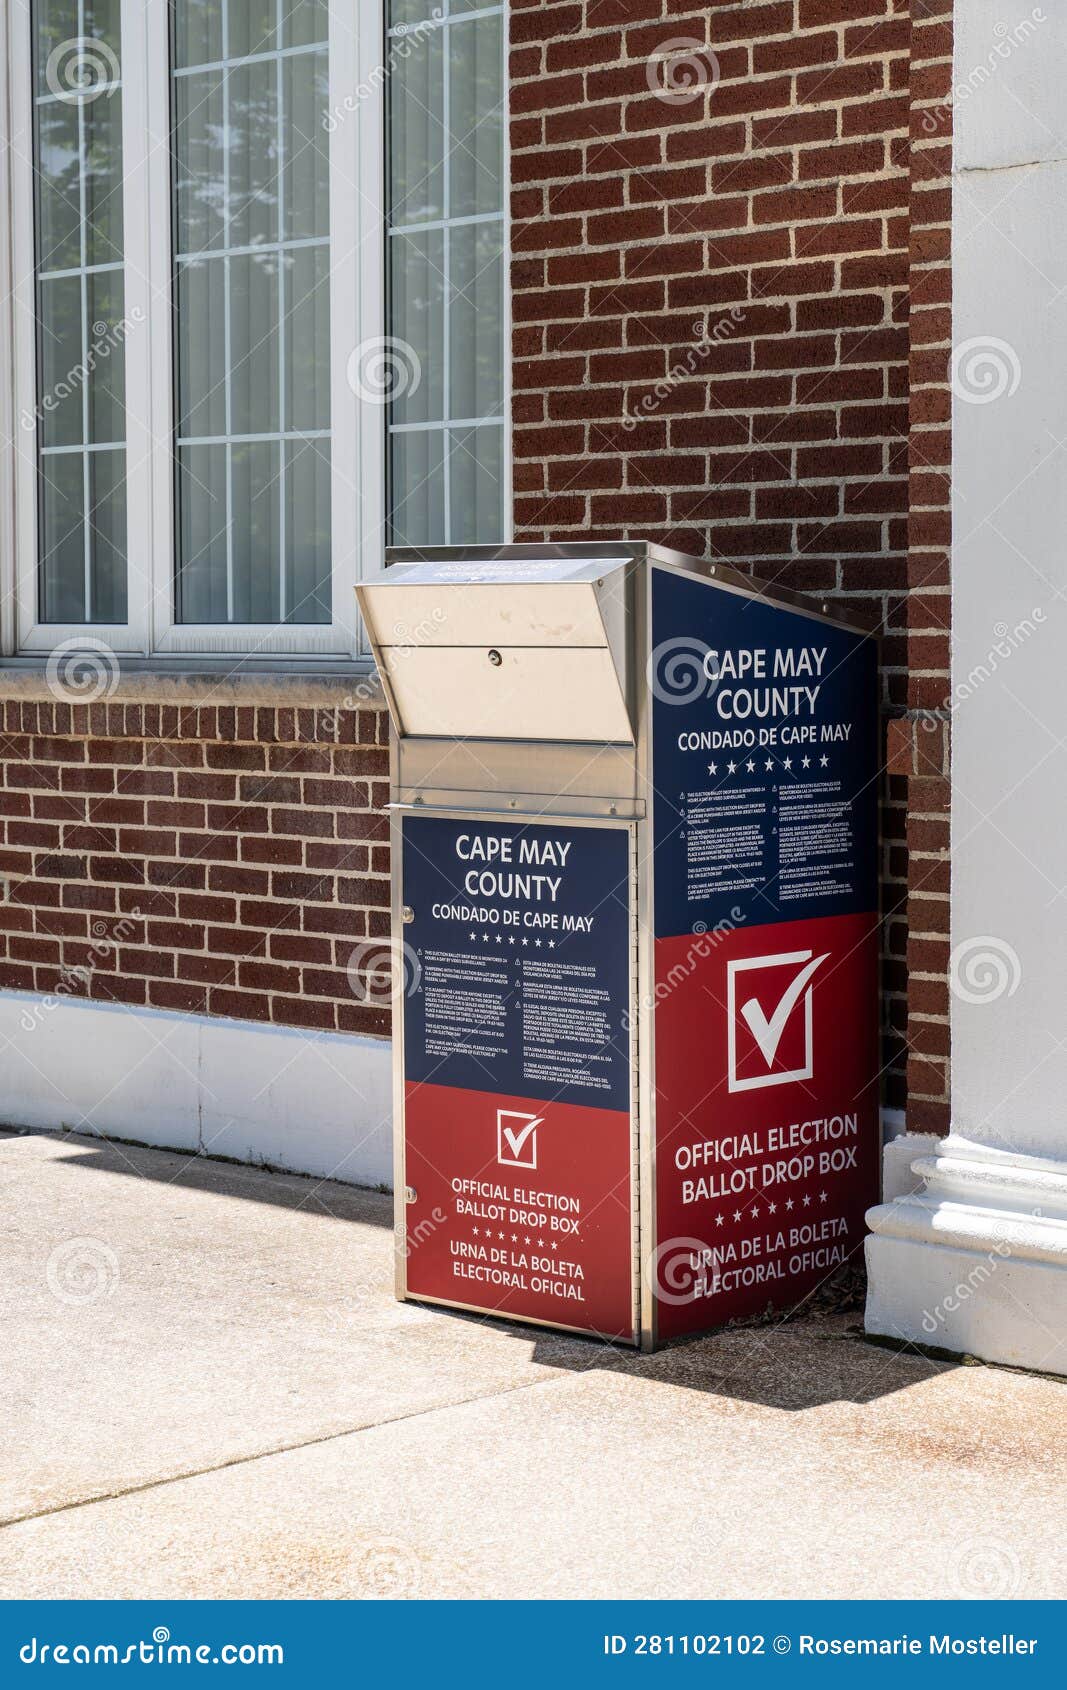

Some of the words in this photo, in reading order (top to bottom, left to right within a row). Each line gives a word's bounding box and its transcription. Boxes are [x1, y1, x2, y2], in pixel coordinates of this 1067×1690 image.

[703, 649, 766, 680] CAPE
[773, 648, 827, 677] MAY
[716, 686, 820, 719] COUNTY
[678, 729, 755, 751] CONDADO
[759, 727, 777, 746] DE
[781, 725, 816, 744] CAPE
[820, 724, 852, 742] MAY
[455, 835, 512, 862] CAPE
[519, 839, 571, 866] MAY
[465, 870, 562, 901] COUNTY
[432, 904, 499, 924] CONDADO
[504, 910, 520, 925] DE
[524, 912, 558, 929] CAPE
[562, 915, 594, 932] MAY
[675, 1132, 764, 1170] OFFICIAL
[768, 1113, 857, 1152] ELECTION
[682, 1166, 758, 1204] BALLOT
[762, 1155, 814, 1188] DROP
[819, 1146, 857, 1175] BOX
[452, 1178, 510, 1201] OFFICIAL
[514, 1188, 580, 1214] ELECTION
[456, 1199, 506, 1220] BALLOT
[510, 1208, 547, 1228] DROP
[550, 1216, 580, 1235] BOX
[450, 1240, 487, 1261] URNA
[491, 1248, 507, 1265] DE
[511, 1252, 528, 1269] LA
[531, 1256, 584, 1280] BOLETA
[690, 1243, 737, 1271] URNA
[741, 1236, 761, 1259] DE
[766, 1232, 786, 1253] LA
[789, 1217, 848, 1248] BOLETA
[453, 1262, 528, 1290] ELECTORAL
[531, 1277, 585, 1301] OFICIAL
[693, 1260, 785, 1300] ELECTORAL
[788, 1244, 849, 1275] OFICIAL
